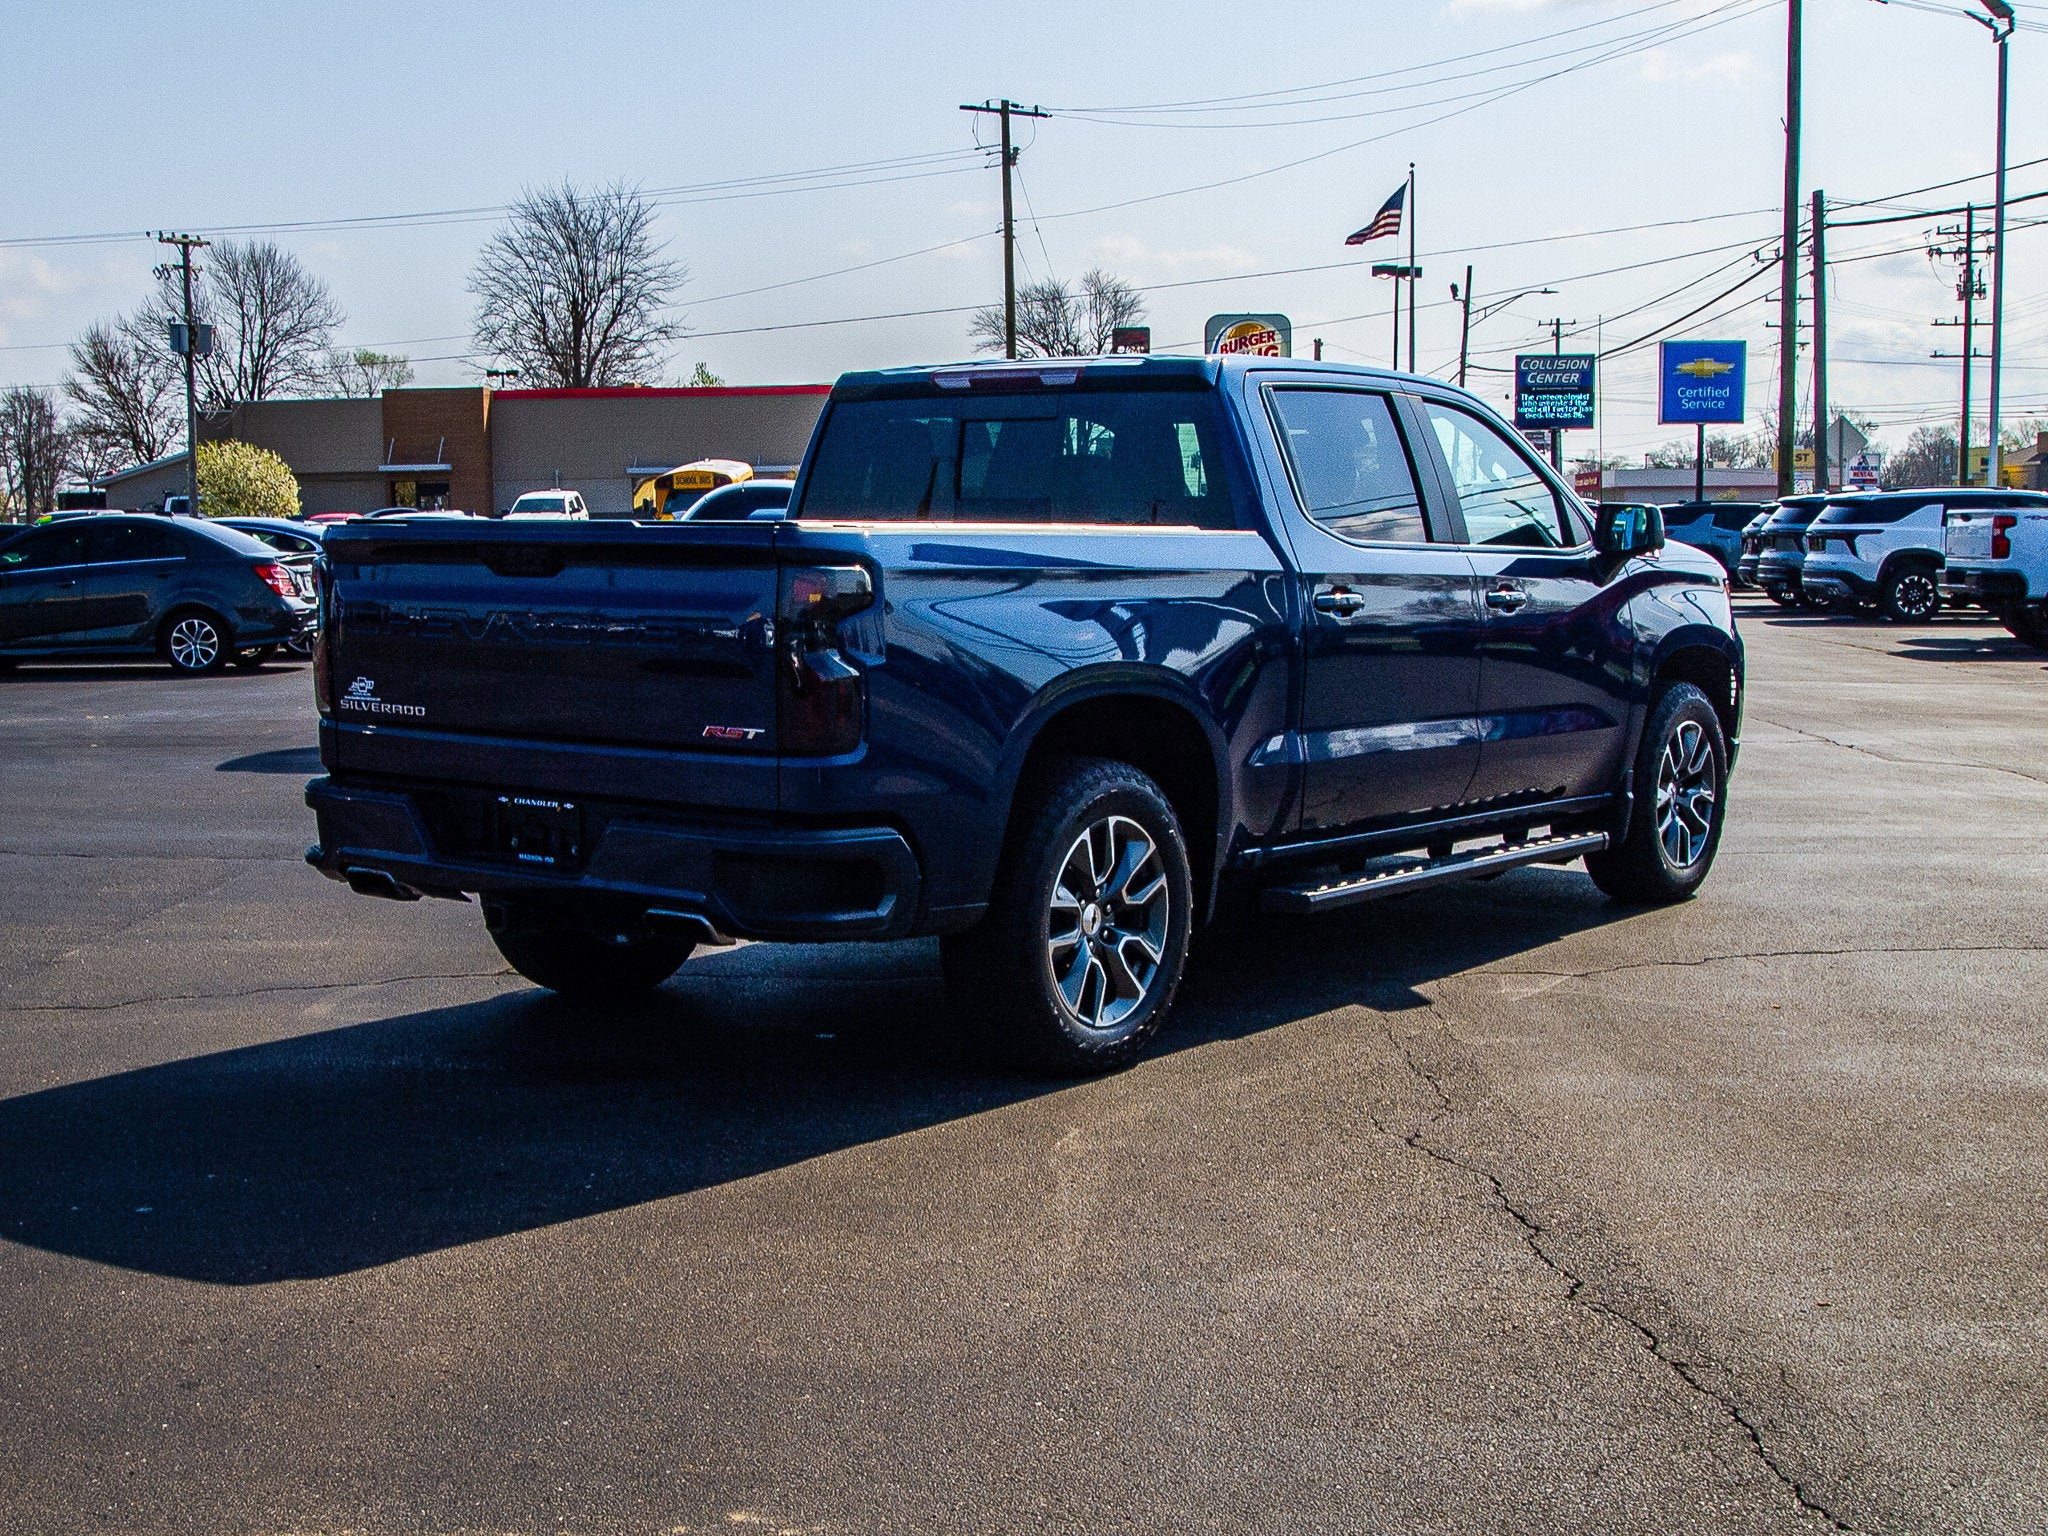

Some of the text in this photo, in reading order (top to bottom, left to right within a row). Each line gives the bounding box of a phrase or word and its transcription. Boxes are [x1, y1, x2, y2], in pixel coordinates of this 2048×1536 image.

[1220, 330, 1276, 354] BURGER
[1520, 358, 1589, 370] COLLISION
[1527, 372, 1579, 384] CENTER
[1677, 386, 1729, 398] Certified
[1681, 398, 1725, 409] Service
[675, 475, 711, 485] SCHOOL BUS
[340, 700, 426, 716] SILVERADO
[702, 725, 765, 740] RST
[514, 797, 559, 808] CHANDLER
